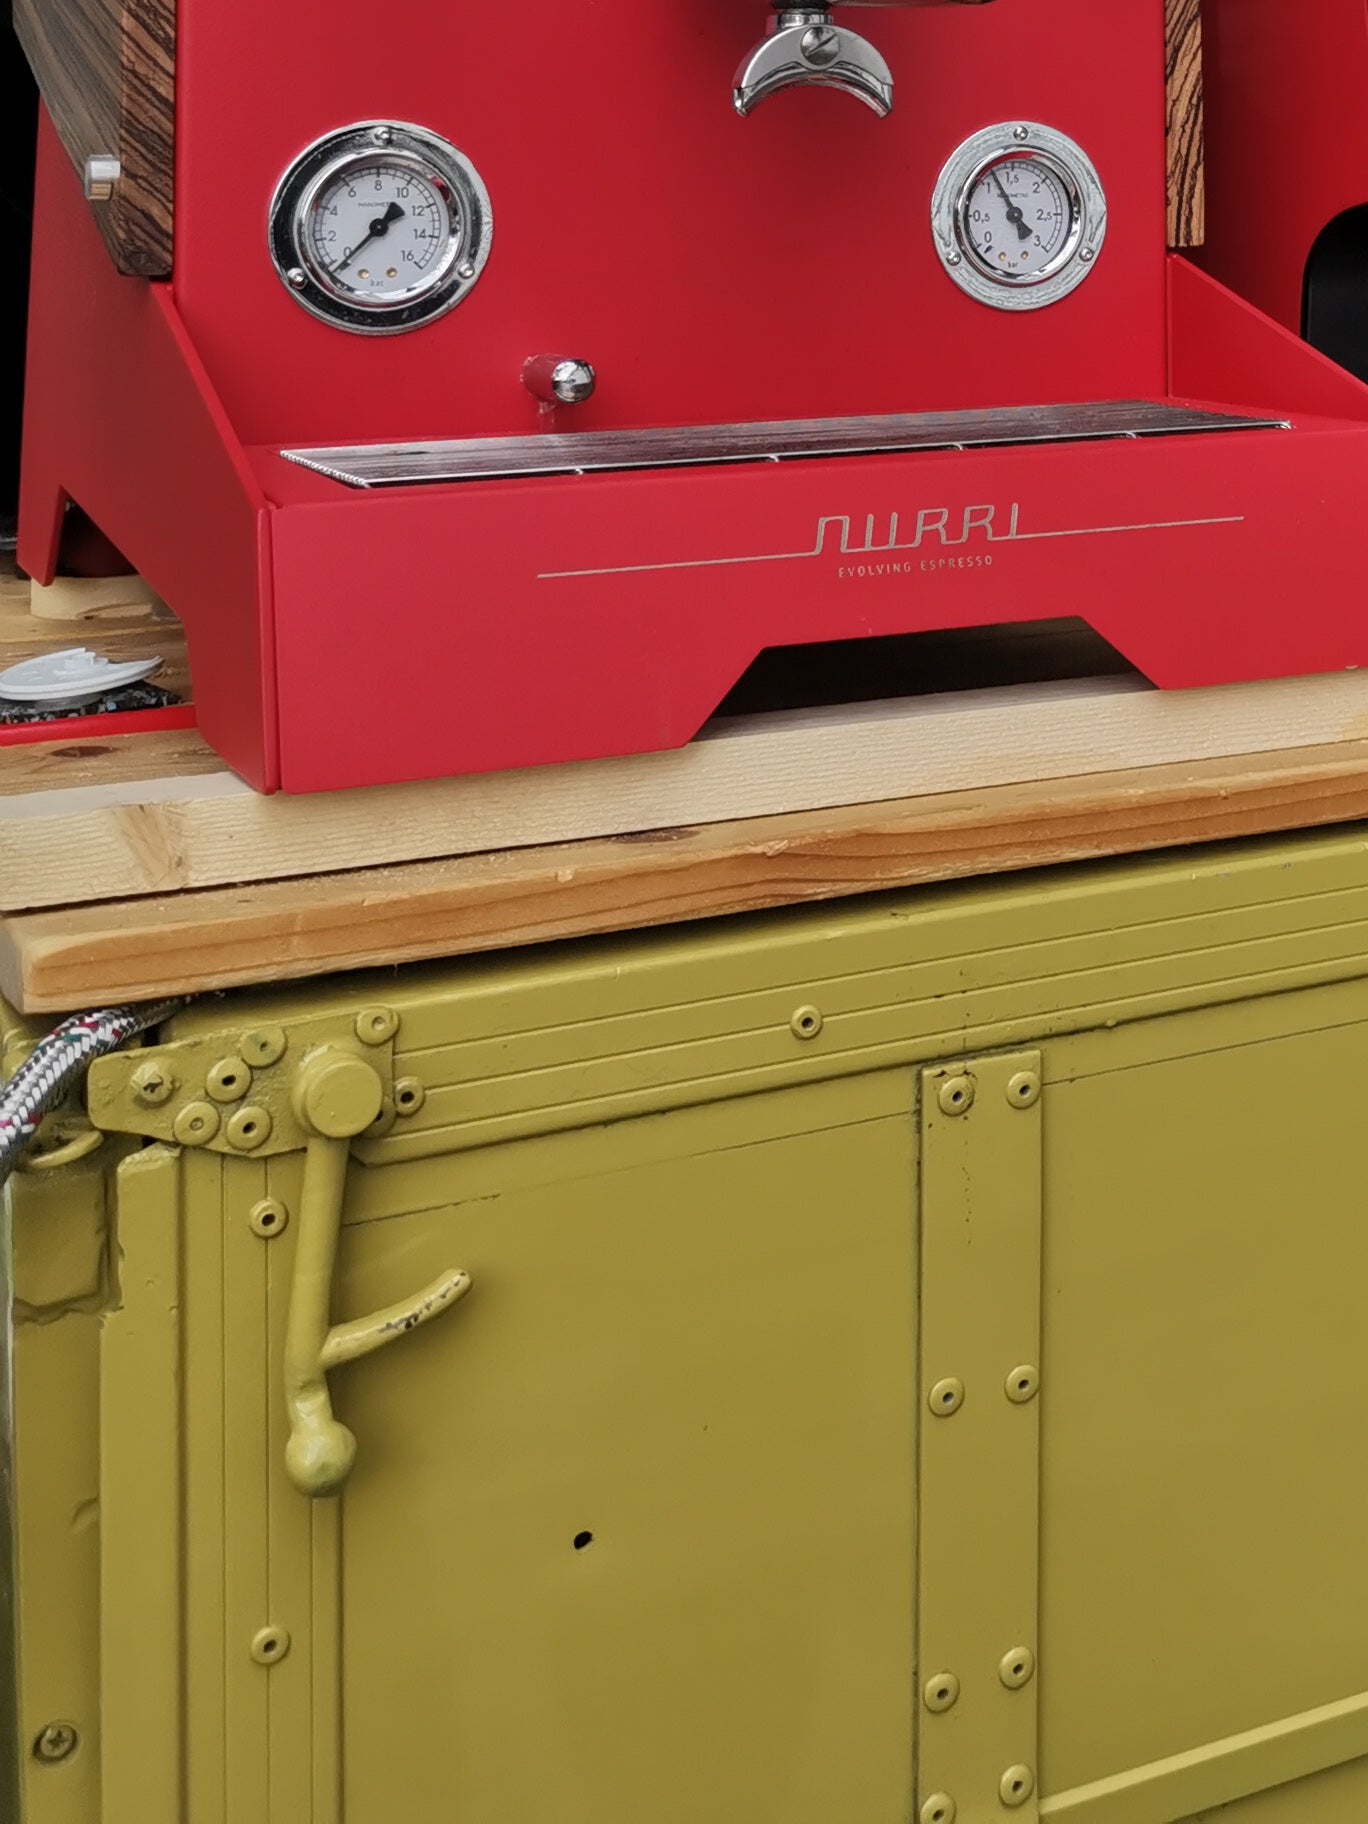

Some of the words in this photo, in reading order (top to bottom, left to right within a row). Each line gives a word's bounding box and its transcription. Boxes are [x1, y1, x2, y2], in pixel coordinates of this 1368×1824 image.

[348, 185, 357, 198] 6
[374, 180, 383, 192] 8
[396, 186, 410, 198] 10
[329, 205, 338, 216] 4
[412, 205, 425, 217] 12
[972, 209, 991, 223] 0,5
[1036, 208, 1053, 222] 2,5
[328, 230, 336, 242] 2
[413, 228, 427, 240] 14
[984, 231, 992, 243] 0
[1033, 234, 1042, 247] 3
[401, 250, 415, 262] 16
[838, 561, 912, 579] EVOLVING
[919, 554, 993, 572] ESPRESSO
